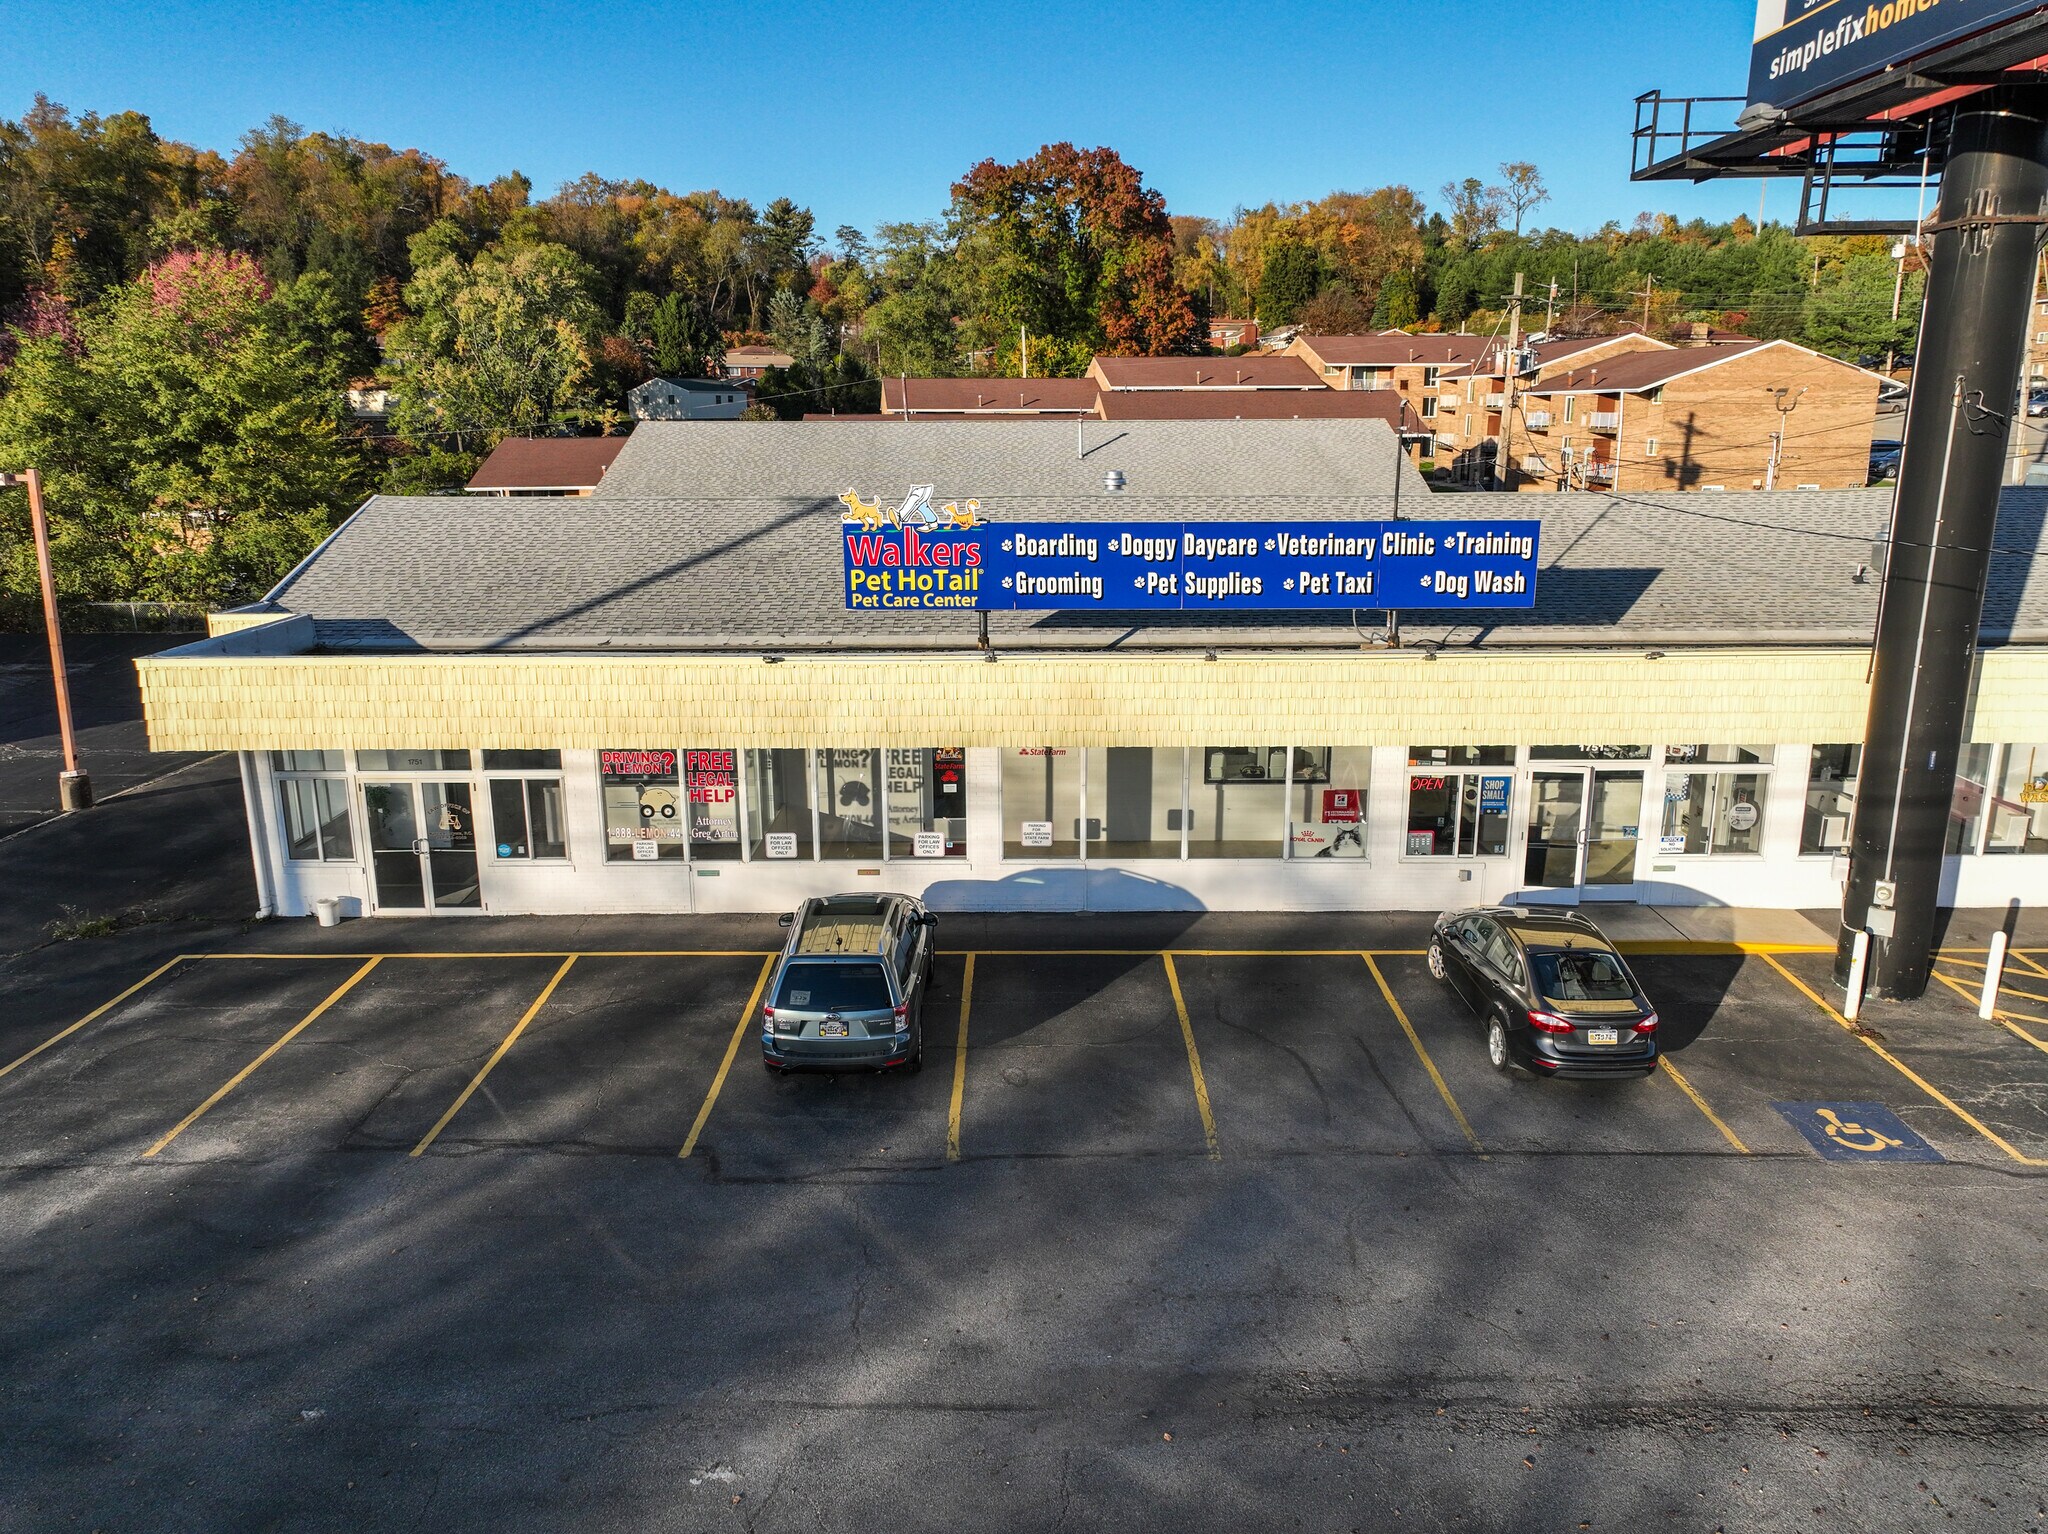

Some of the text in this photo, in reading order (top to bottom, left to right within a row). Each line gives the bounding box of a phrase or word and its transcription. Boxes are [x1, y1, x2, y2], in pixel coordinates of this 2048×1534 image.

[1769, 0, 1942, 79] simplefixhome
[847, 525, 982, 568] Walkers
[1015, 531, 1534, 561] Boarding Doggy Daycare Veterinary Clinic Training
[850, 569, 891, 591] Pet
[1015, 570, 1526, 600] Grooming Pet Supplies Pet Taxi Dog Wash
[851, 593, 978, 608] Pet Care Center
[602, 763, 613, 774] A
[687, 751, 733, 771] FREE
[688, 772, 734, 787] LEGAL
[1410, 778, 1445, 791] OPEN
[1485, 780, 1505, 790] SHOP
[689, 789, 735, 803] HELP
[1482, 790, 1505, 800] SMALL
[695, 816, 733, 828] Attorney
[691, 827, 711, 841] Greg
